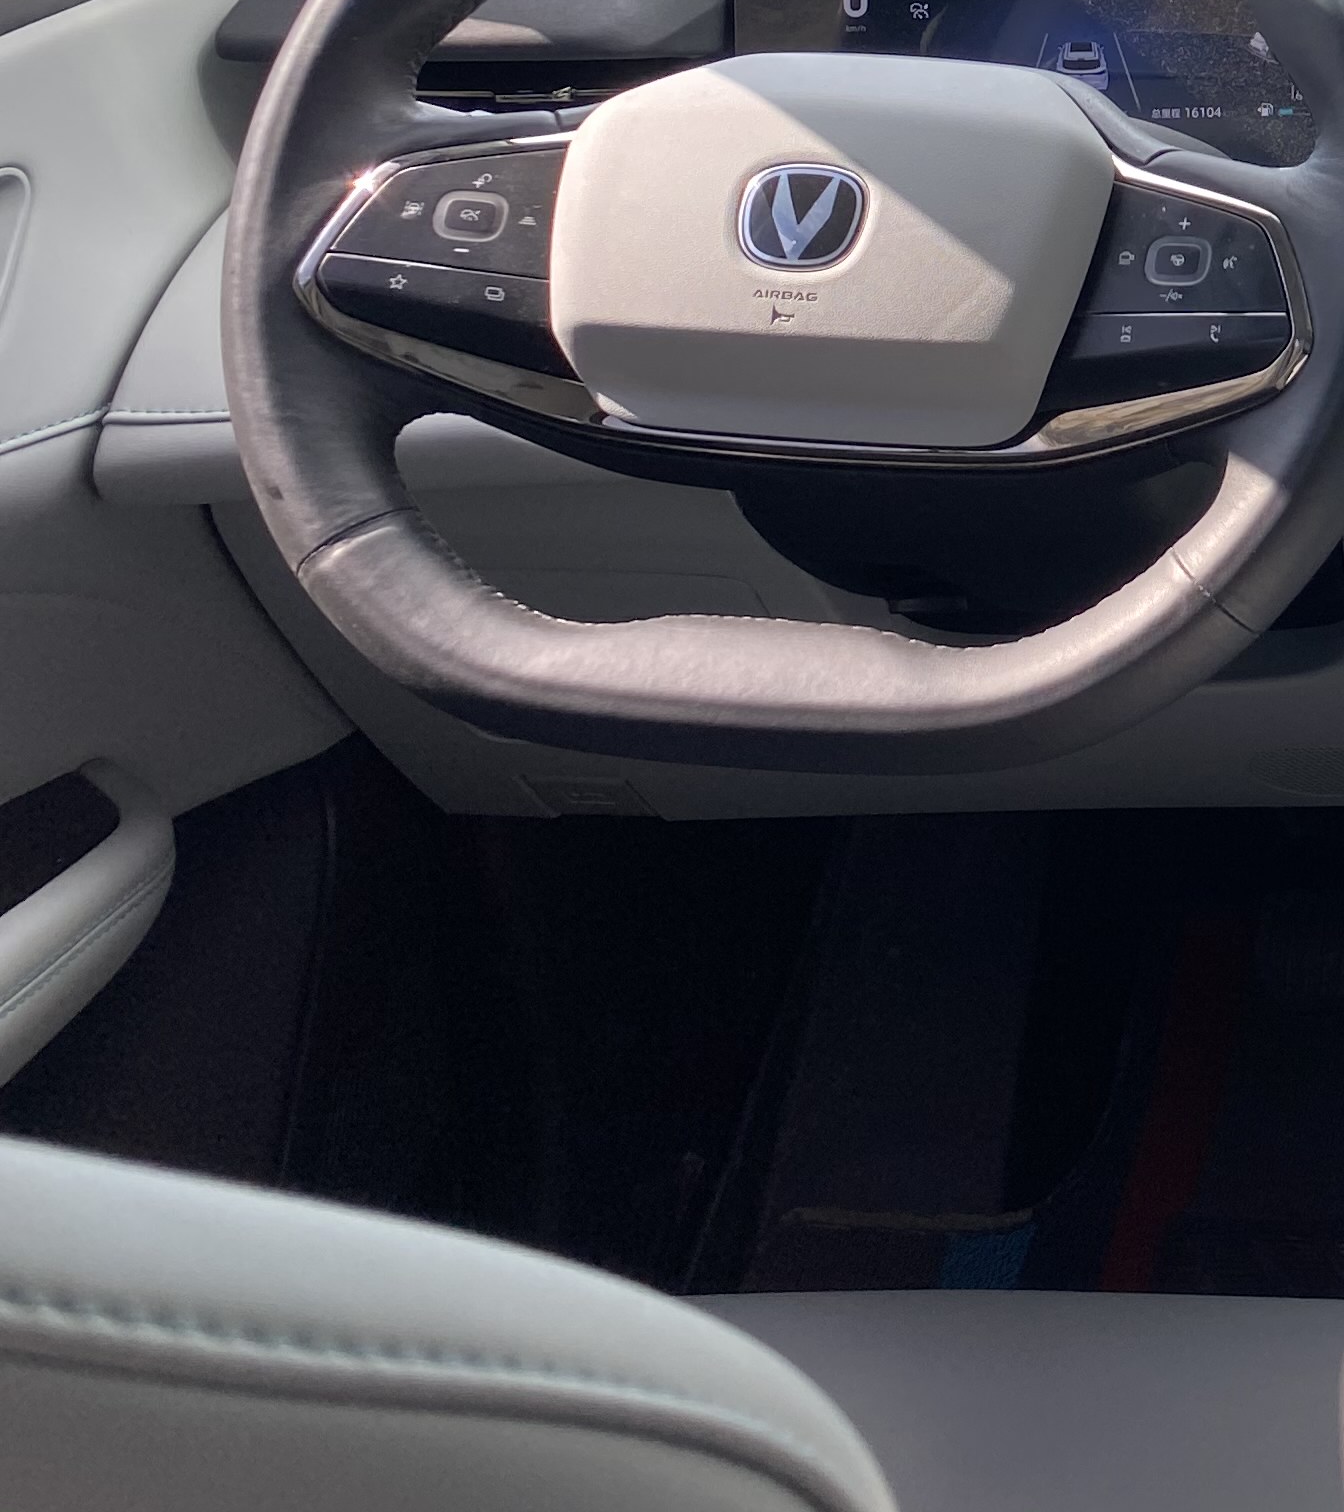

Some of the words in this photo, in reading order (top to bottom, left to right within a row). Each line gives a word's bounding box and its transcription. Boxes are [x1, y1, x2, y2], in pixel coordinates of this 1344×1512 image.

[1151, 107, 1182, 119] 总里程
[1185, 106, 1222, 119] 16104
[752, 289, 818, 302] AIRBAG
